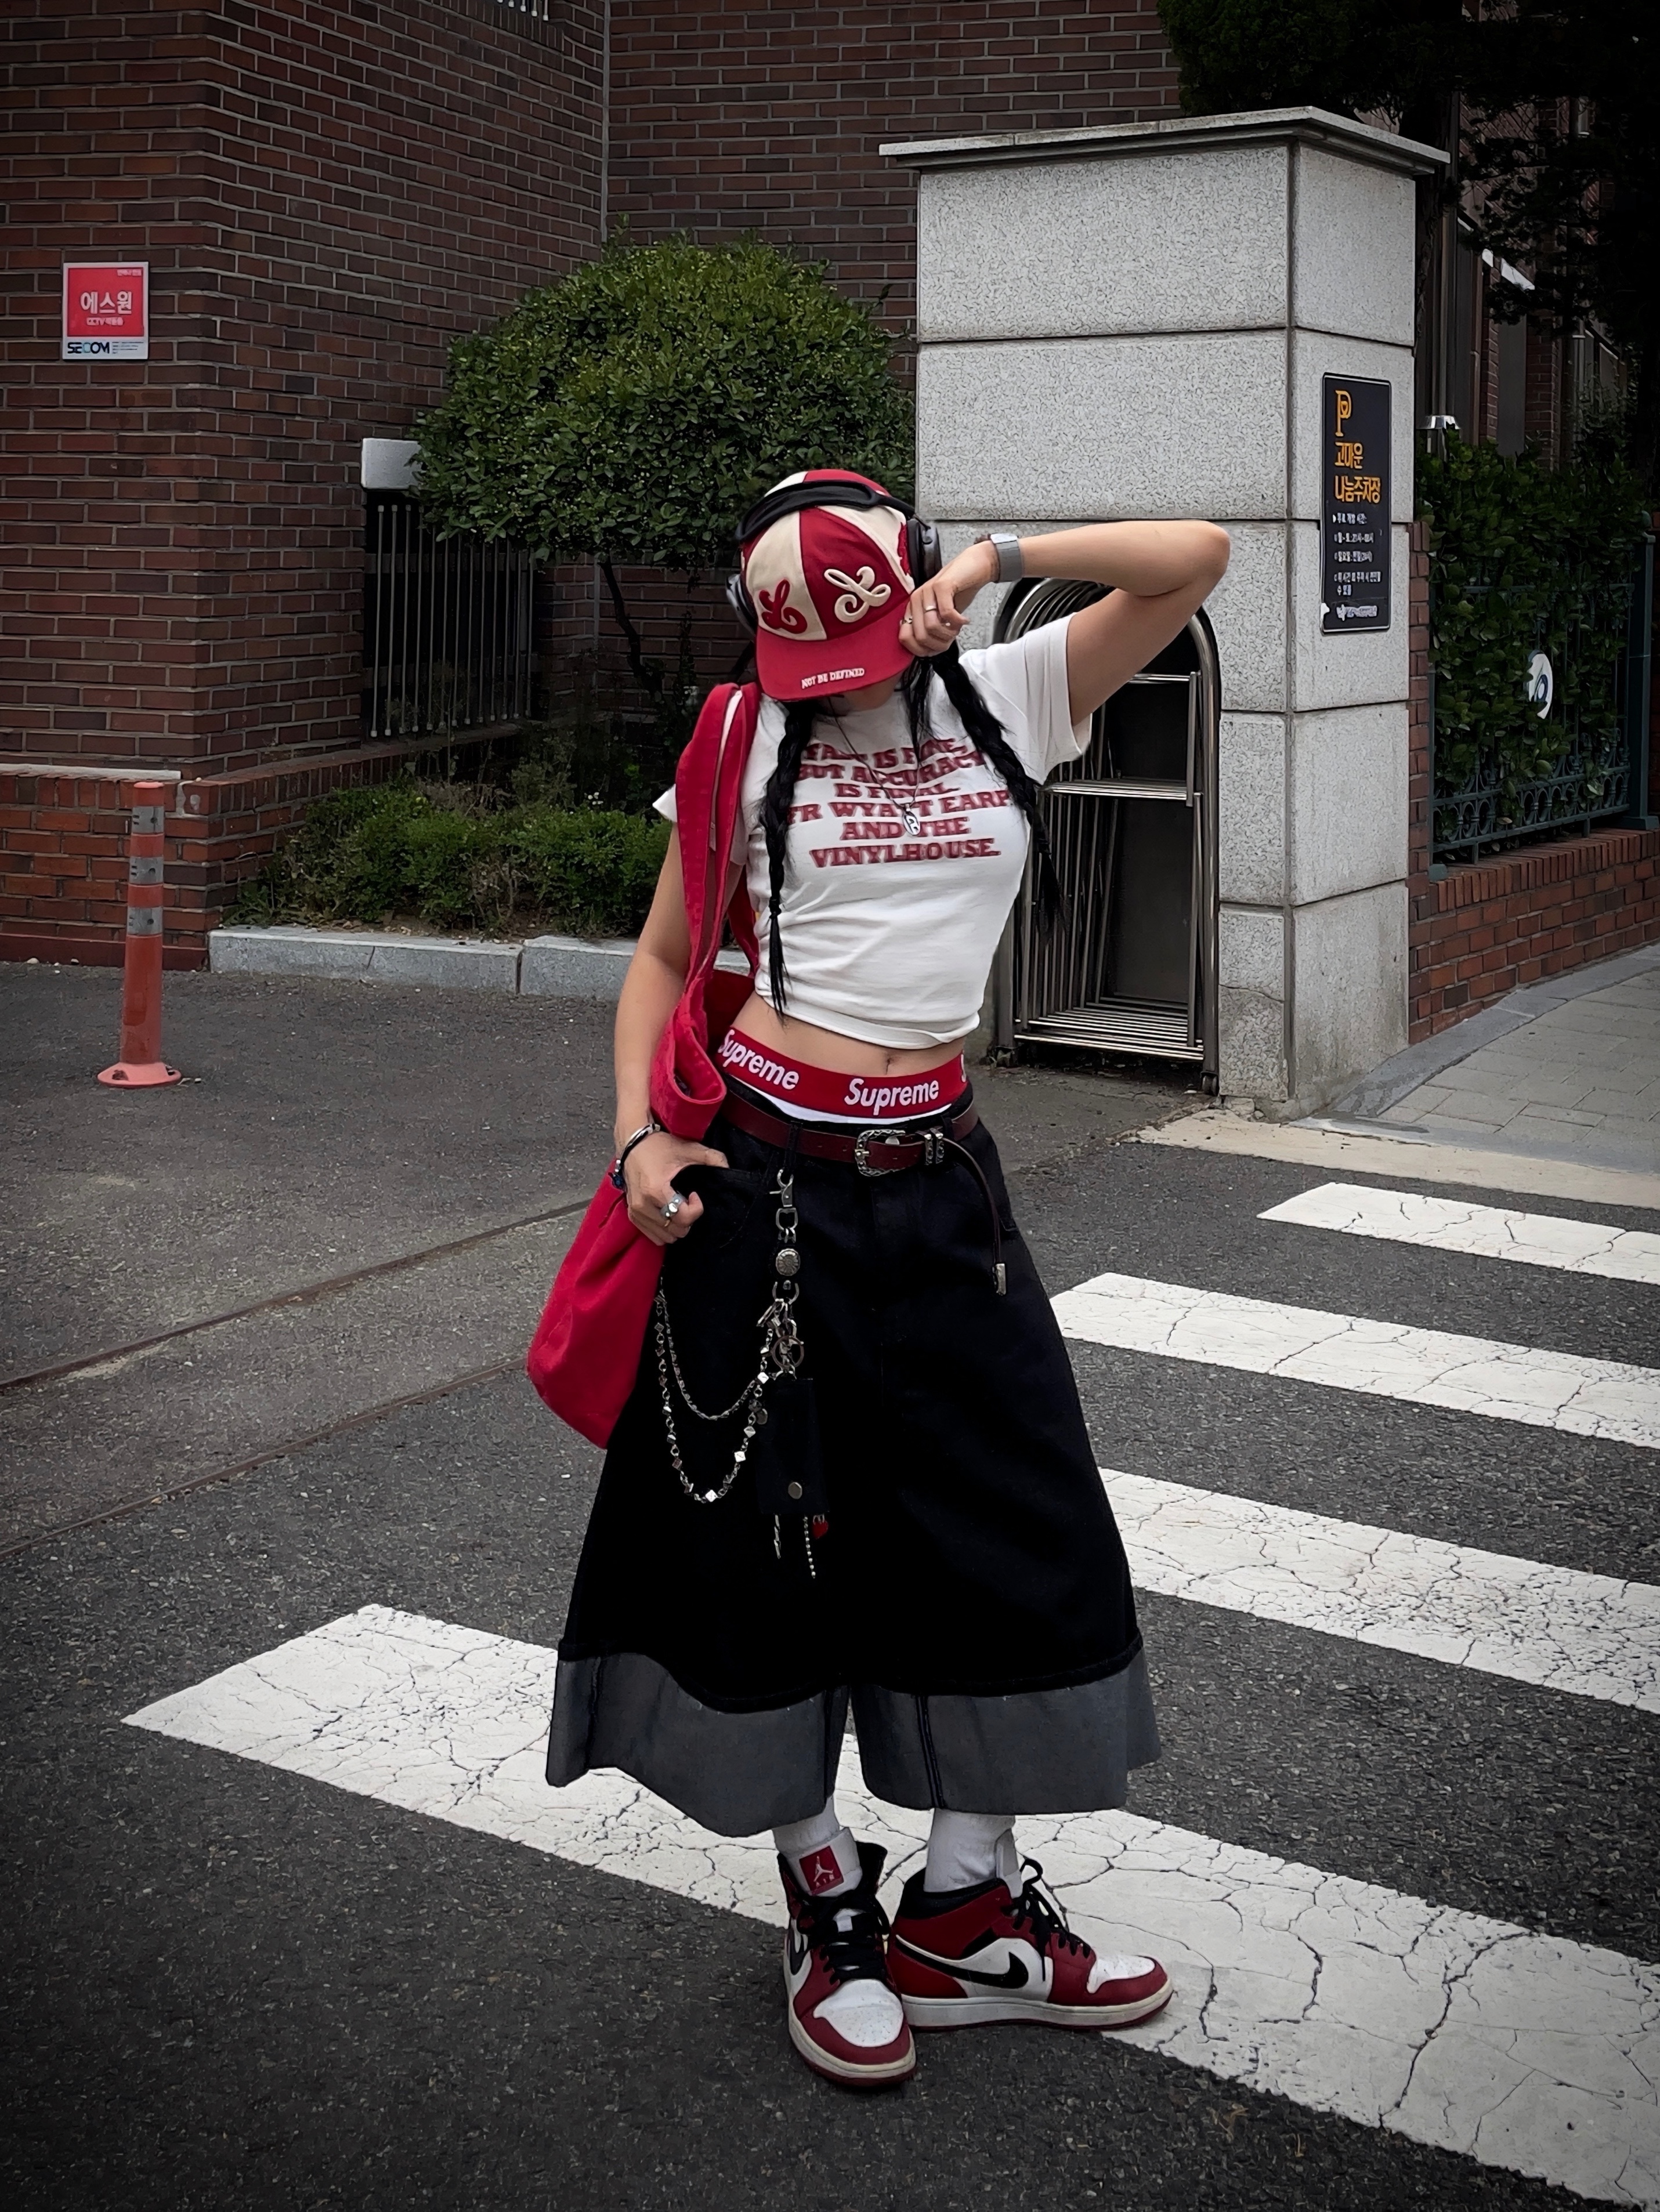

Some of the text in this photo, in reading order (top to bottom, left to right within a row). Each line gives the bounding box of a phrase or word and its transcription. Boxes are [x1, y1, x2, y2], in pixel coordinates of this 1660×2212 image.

[80, 290, 132, 314] 에스원
[1334, 390, 1352, 437] P
[1334, 441, 1364, 469] 고마운
[1334, 475, 1381, 504] 나눔주차장
[801, 668, 865, 689] NOT BE DEFINED
[873, 748, 899, 769] IS
[834, 783, 862, 798] IS
[828, 799, 934, 817] WYAT
[840, 821, 905, 841] AND
[717, 1029, 939, 1116] Supreme Supreme
